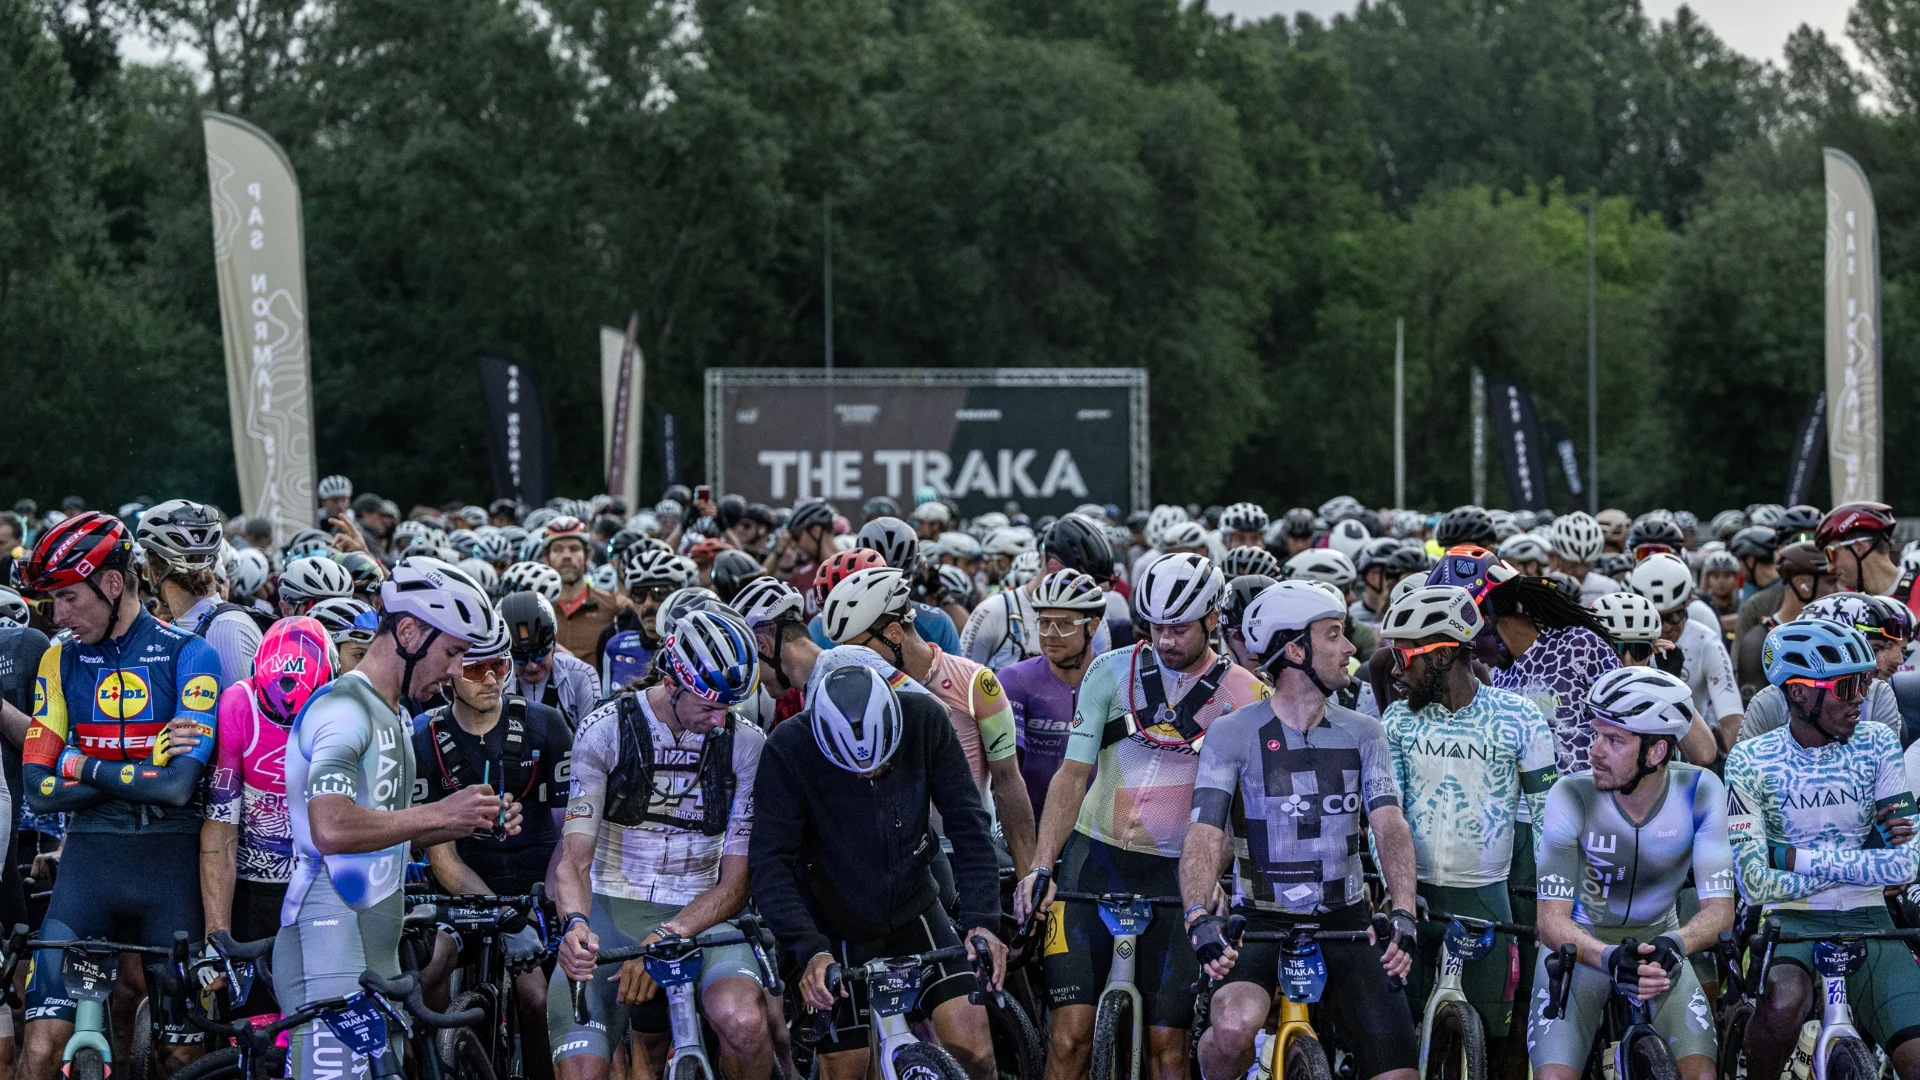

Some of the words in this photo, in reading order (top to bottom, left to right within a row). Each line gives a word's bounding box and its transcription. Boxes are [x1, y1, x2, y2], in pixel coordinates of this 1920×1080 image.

[758, 450, 863, 498] THE
[873, 448, 1089, 498] TRAKA
[50, 528, 84, 563] TREK
[425, 571, 444, 588] LLUM
[1448, 592, 1467, 611] AMANI
[154, 623, 183, 641] TREK
[1449, 619, 1465, 632] poc
[1769, 633, 1782, 652] poc
[139, 654, 170, 663] SRAM
[1838, 645, 1850, 664] poc
[1407, 739, 1497, 762] AMANI
[312, 781, 357, 800] LLUM
[1780, 784, 1866, 810] AMANI
[312, 918, 340, 927] tactic
[82, 960, 100, 971] THE
[1289, 959, 1305, 968] THE
[73, 963, 107, 980] TRAKA
[671, 968, 681, 976] 46
[1284, 966, 1315, 977] TRAKA
[83, 981, 94, 990] 38
[43, 996, 78, 1008] Santini
[891, 996, 900, 1005] 27
[339, 1009, 358, 1021] THE
[337, 1015, 371, 1031] TRAKA
[361, 1033, 370, 1042] 21
